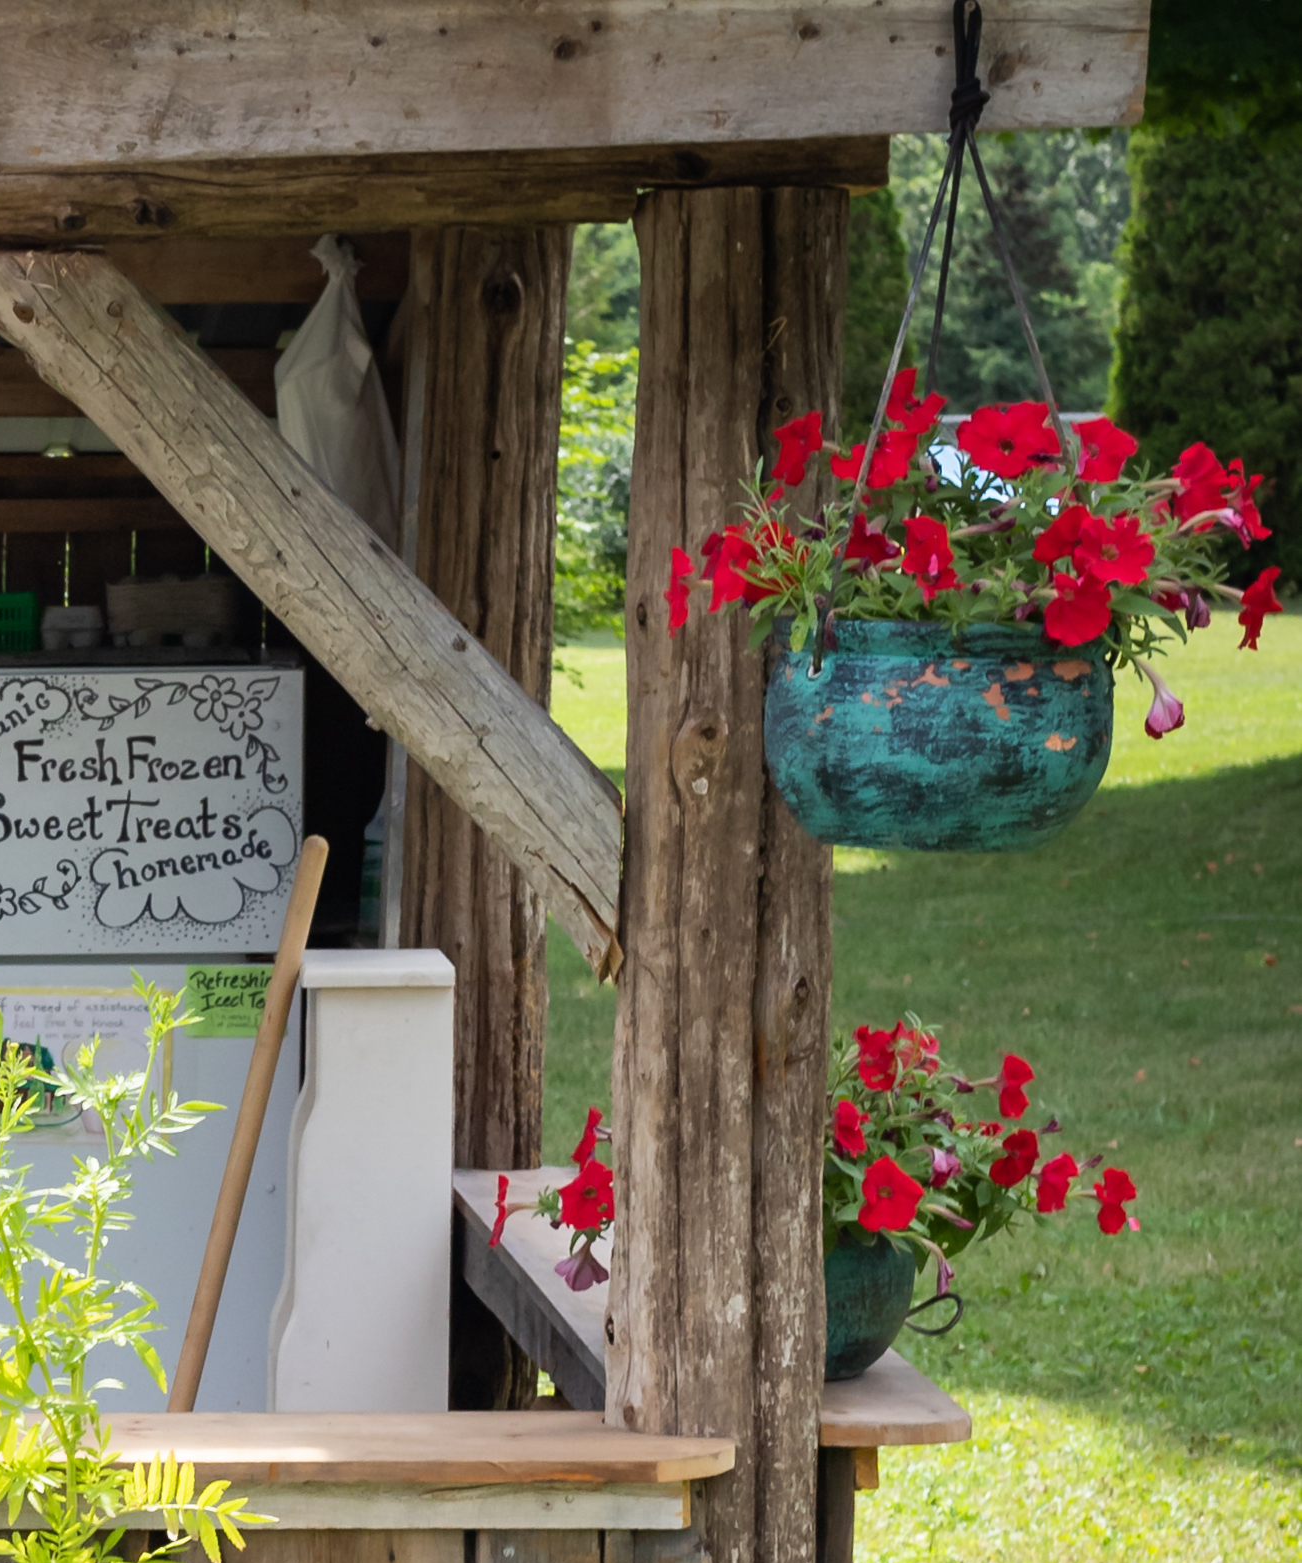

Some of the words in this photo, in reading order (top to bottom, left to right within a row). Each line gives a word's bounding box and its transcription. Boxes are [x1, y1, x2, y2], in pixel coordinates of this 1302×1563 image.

[13, 737, 123, 786] Fresh
[126, 735, 246, 783] Frozen
[105, 789, 243, 844] Treats
[112, 828, 273, 890] homemade
[13, 1001, 26, 1012] in
[30, 1000, 62, 1013] need
[66, 998, 81, 1012] of
[84, 998, 150, 1013] assistance
[189, 970, 272, 991] Refreshin
